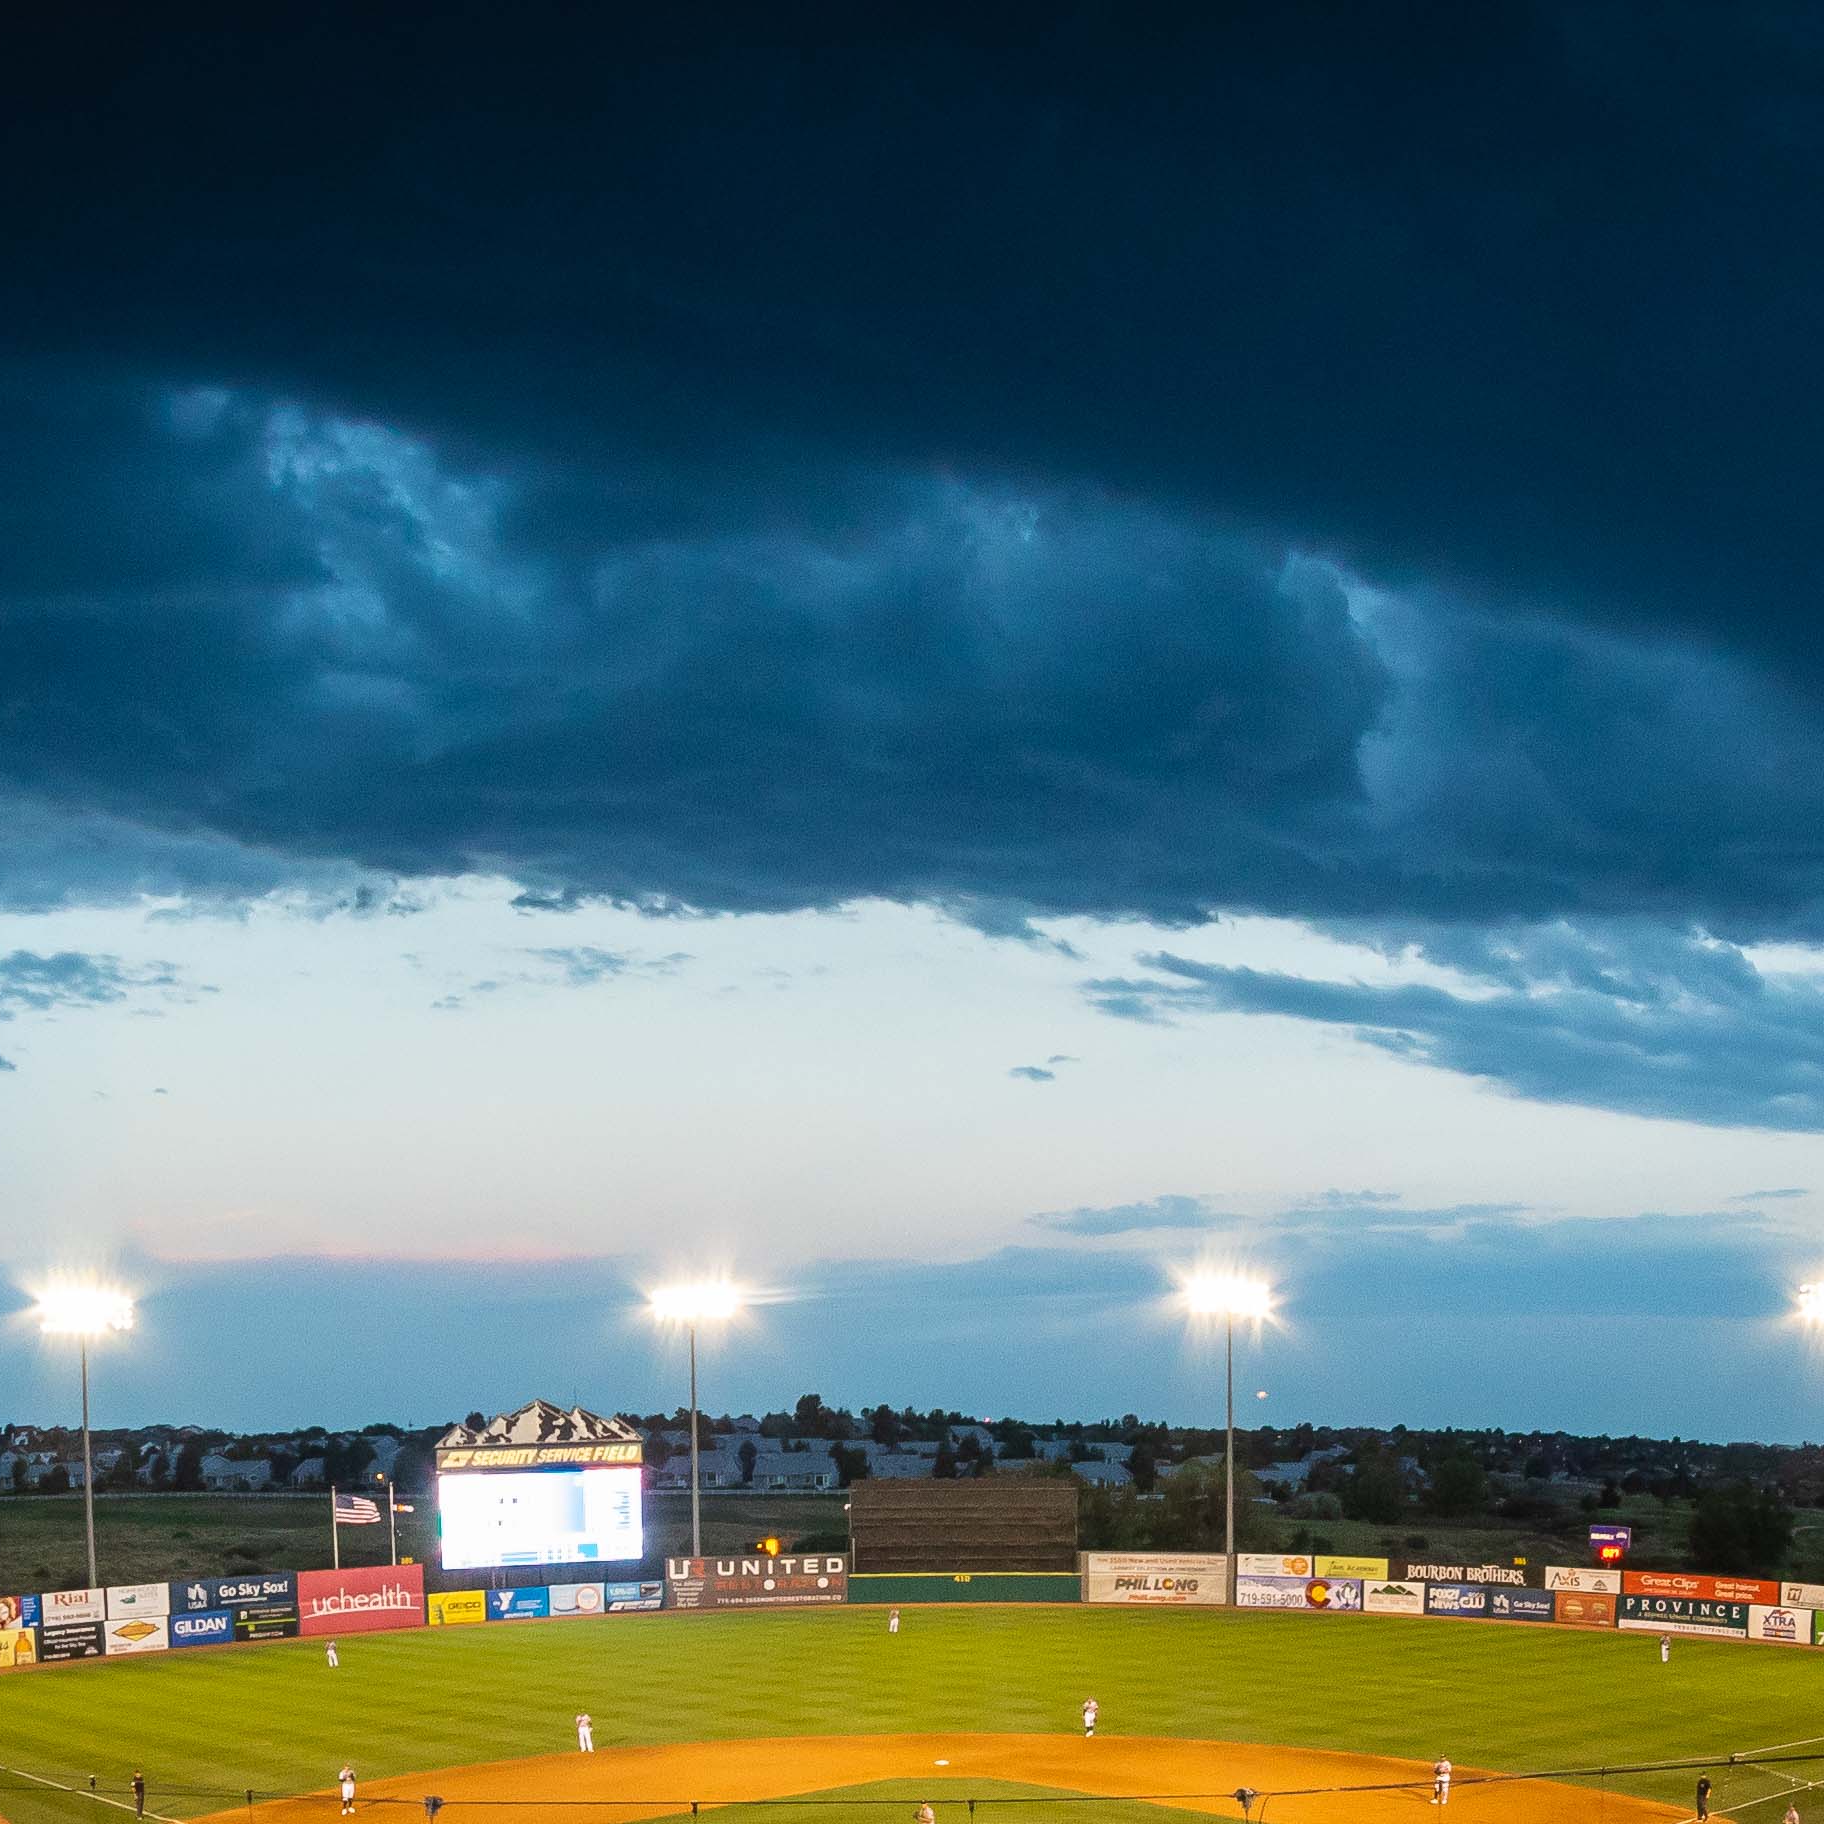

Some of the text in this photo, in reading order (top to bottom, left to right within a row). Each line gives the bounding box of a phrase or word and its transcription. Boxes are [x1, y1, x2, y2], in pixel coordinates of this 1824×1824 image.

[472, 1445, 639, 1466] SECURITY SERVICE FIELD
[716, 1558, 844, 1577] UNITED
[1404, 1564, 1527, 1587] BOURBON BROTHERS
[1640, 1575, 1698, 1590] Great Clips
[219, 1580, 289, 1598] Go Sky Sox!
[1114, 1578, 1199, 1592] PHIL LONG
[1714, 1581, 1734, 1591] Great
[54, 1591, 89, 1607] Rial
[312, 1583, 412, 1616] uchealth
[1240, 1592, 1303, 1606] 719-591-5000
[1714, 1590, 1735, 1599] Great
[188, 1600, 208, 1610] USAA
[448, 1602, 481, 1610] GEICO
[1429, 1599, 1460, 1611] NEWS
[1513, 1600, 1524, 1608] Go
[1626, 1598, 1741, 1619] PROVINCE
[175, 1616, 227, 1635] GILDAN
[1762, 1614, 1796, 1628] XTRA
